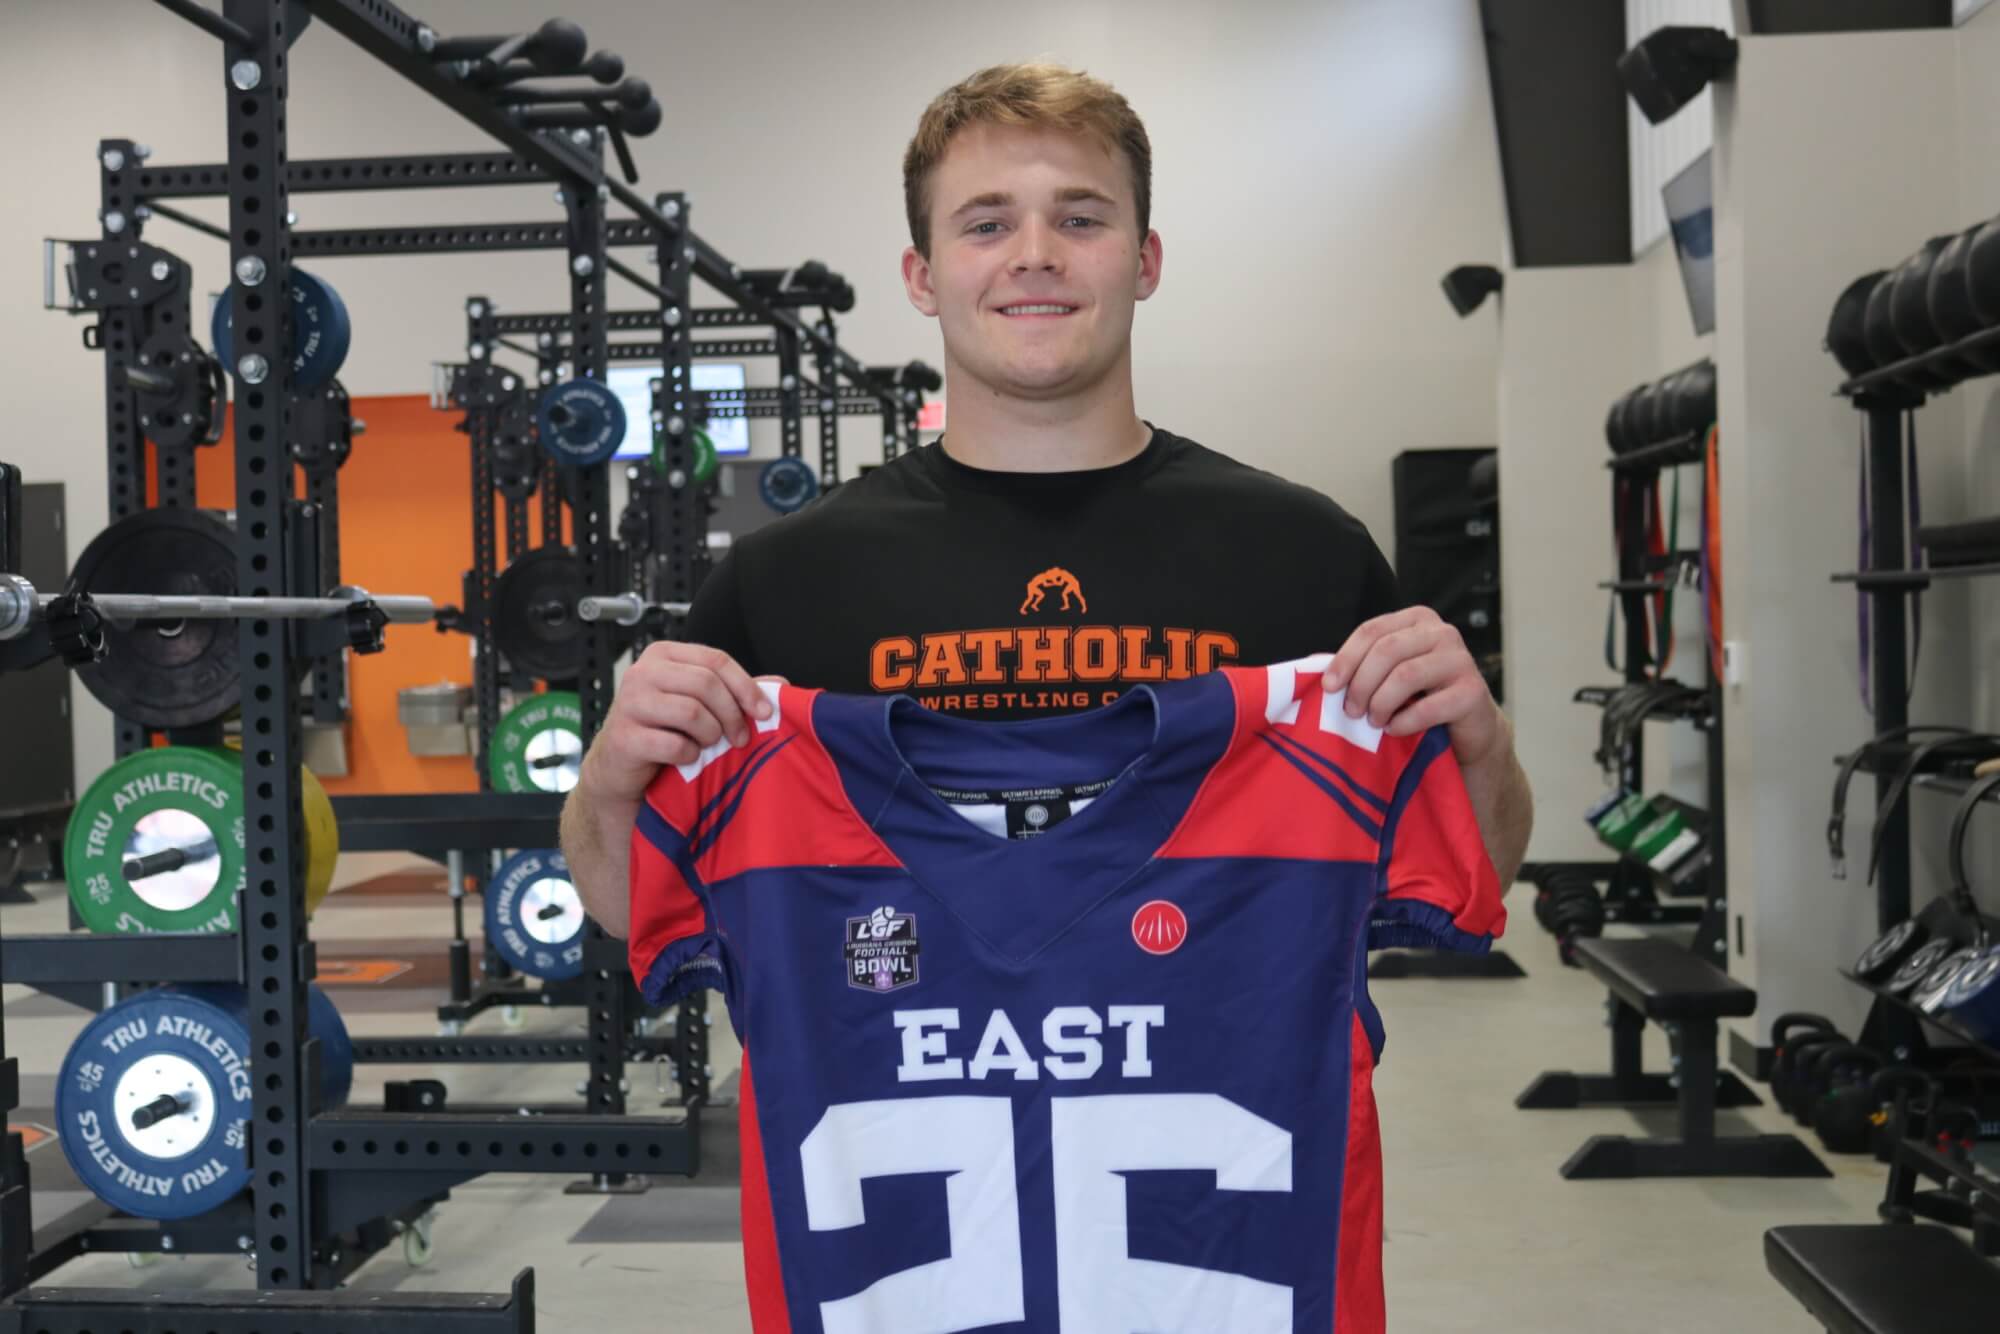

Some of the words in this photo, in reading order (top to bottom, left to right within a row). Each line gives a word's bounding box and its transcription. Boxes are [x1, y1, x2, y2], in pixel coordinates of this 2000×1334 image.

[870, 625, 1239, 692] CATHOLIC
[919, 691, 1090, 711] WRESTLING
[86, 811, 113, 858] TRU
[113, 772, 229, 812] ATHLETICS
[854, 946, 908, 958] FOOTBALL
[856, 920, 906, 939] LGF
[854, 957, 912, 976] BOWL
[101, 1017, 148, 1054] TRU
[155, 1015, 252, 1102] ATHLETICS
[893, 1004, 1165, 1082] EAST
[78, 1110, 174, 1196] ATHLETICS
[181, 1158, 229, 1193] TRU
